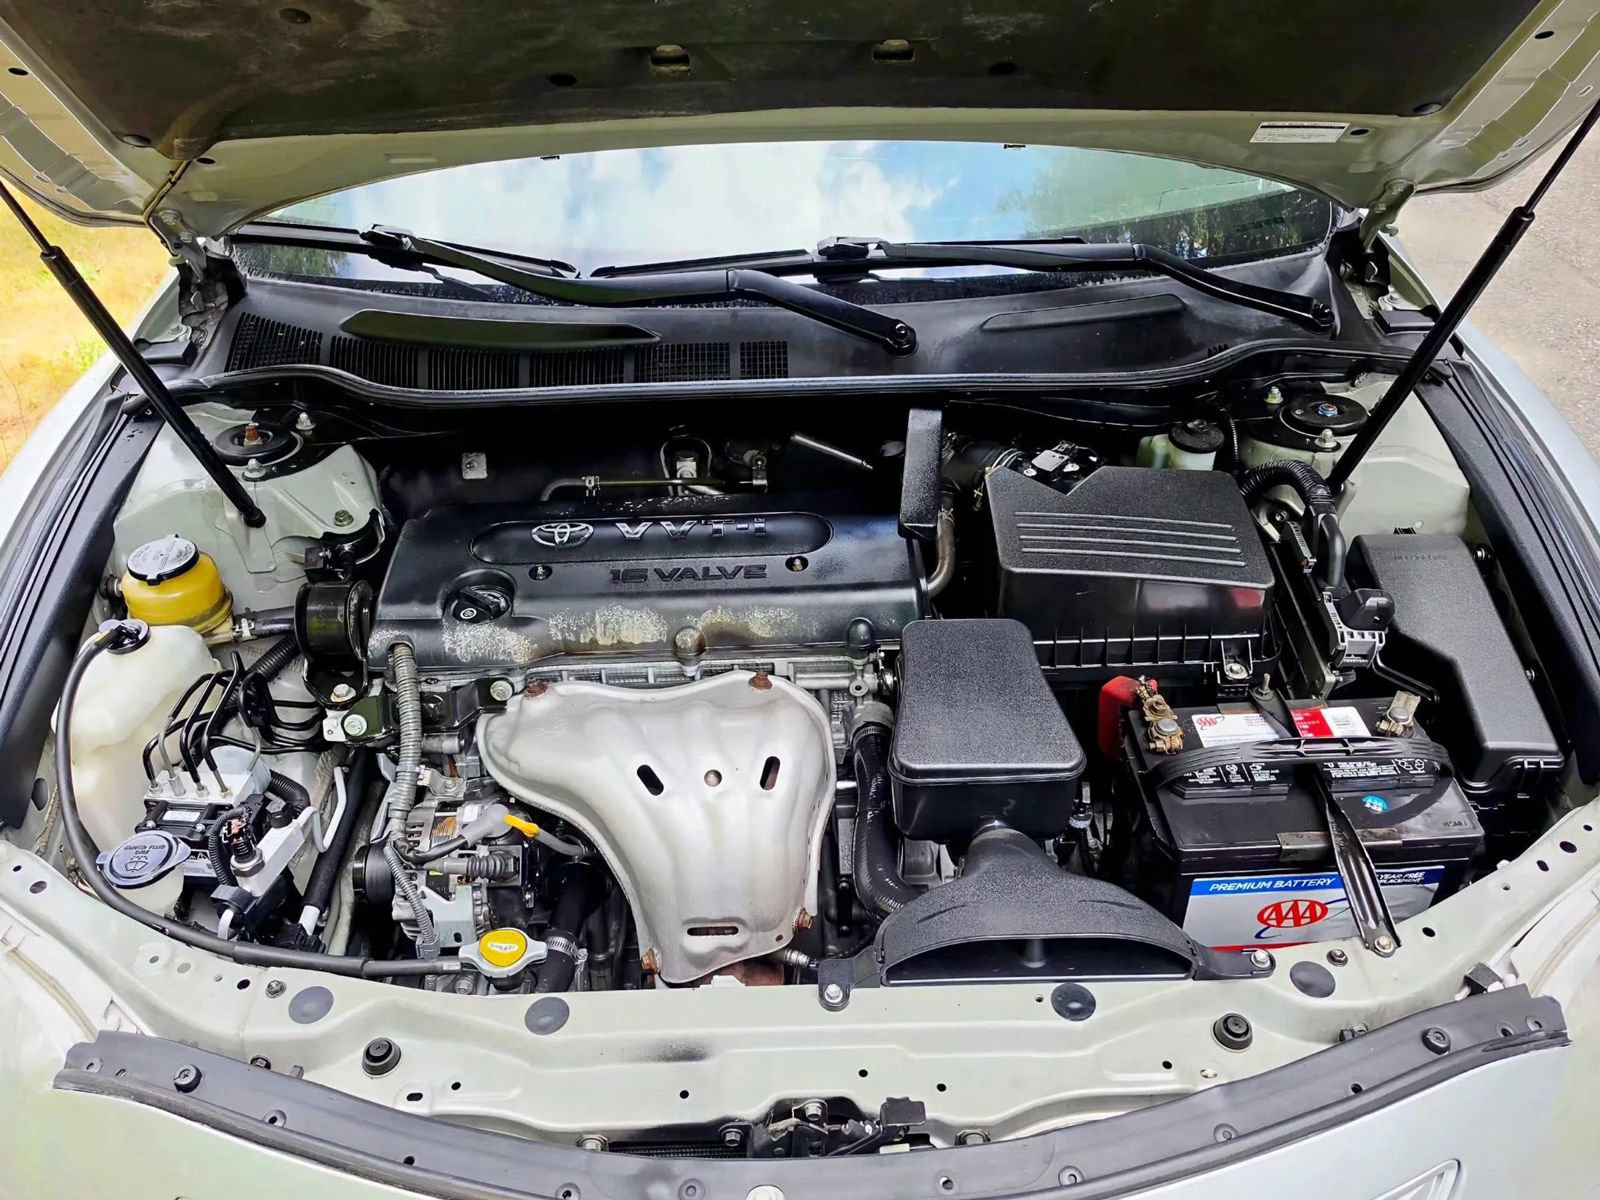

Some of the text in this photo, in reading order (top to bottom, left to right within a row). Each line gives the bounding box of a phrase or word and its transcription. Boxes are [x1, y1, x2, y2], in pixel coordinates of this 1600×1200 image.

[609, 564, 767, 584] 16 VALVE
[1196, 716, 1218, 727] AAA
[1402, 871, 1426, 879] FREE
[1209, 877, 1336, 892] PREMIUM BATTERY
[1260, 900, 1322, 928] AAA
